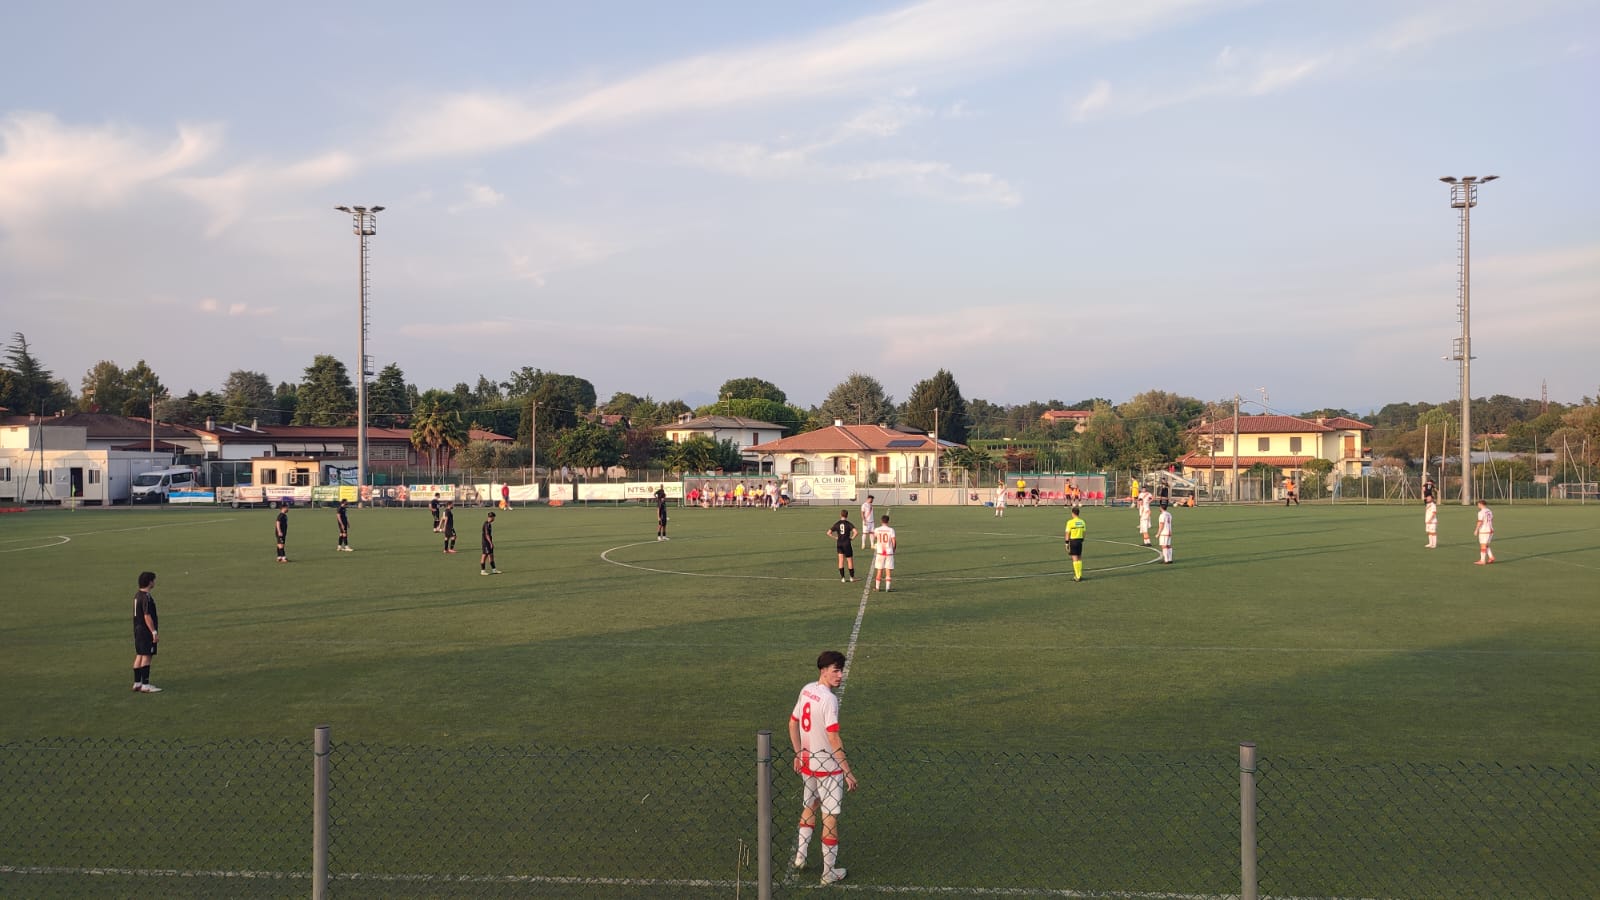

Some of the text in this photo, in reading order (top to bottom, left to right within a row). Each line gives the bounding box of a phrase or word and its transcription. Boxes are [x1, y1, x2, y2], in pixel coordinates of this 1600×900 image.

[839, 523, 846, 535] 9
[878, 532, 889, 543] 10
[801, 702, 811, 733] 8
